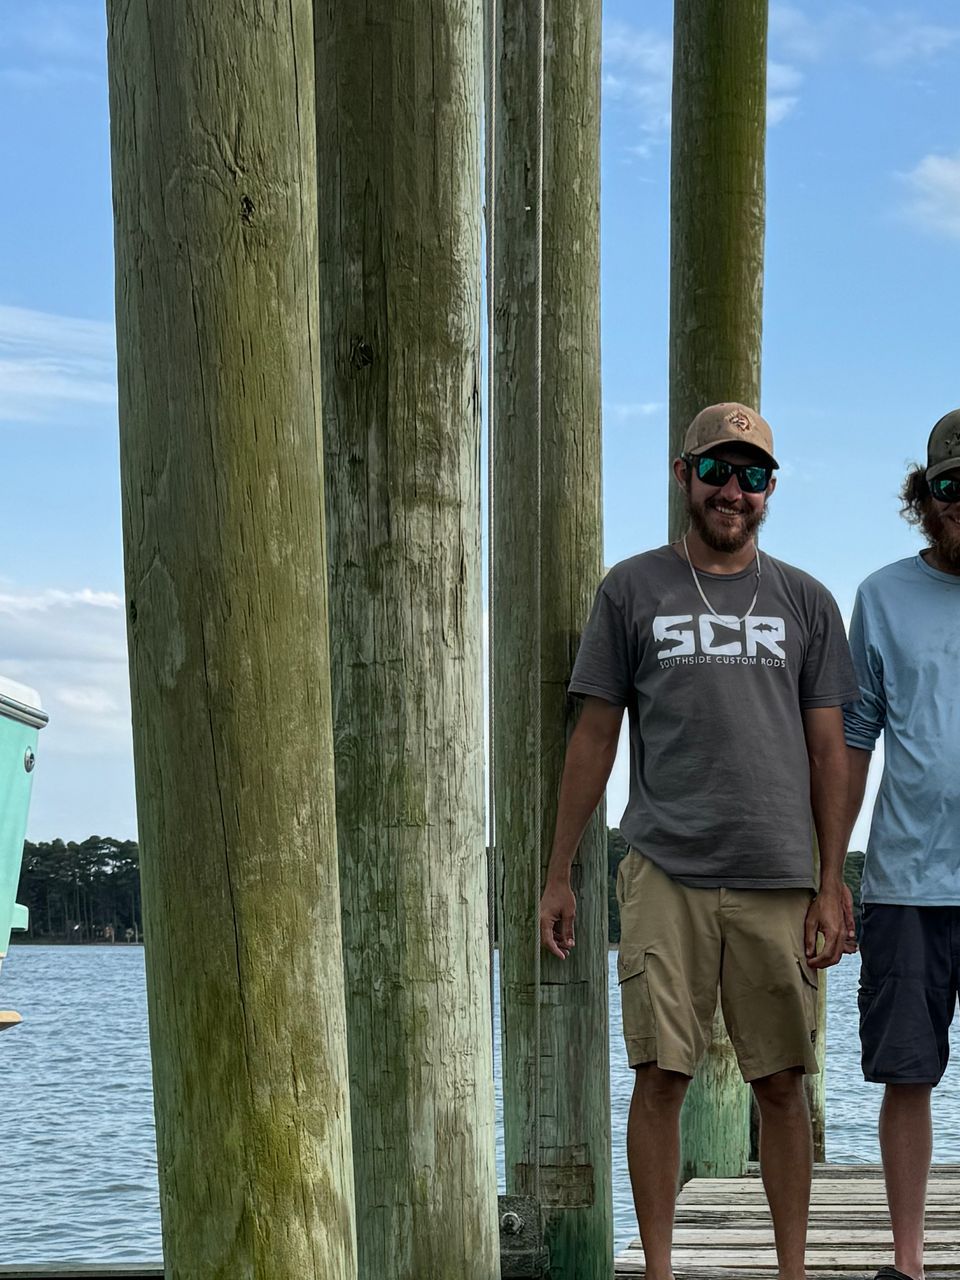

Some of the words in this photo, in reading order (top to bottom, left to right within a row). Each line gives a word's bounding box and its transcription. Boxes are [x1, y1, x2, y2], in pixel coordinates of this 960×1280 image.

[653, 614, 786, 659] SCR
[659, 655, 712, 669] SOUTHSIDE
[715, 656, 757, 665] CUSTOM
[760, 658, 786, 668] RODS
